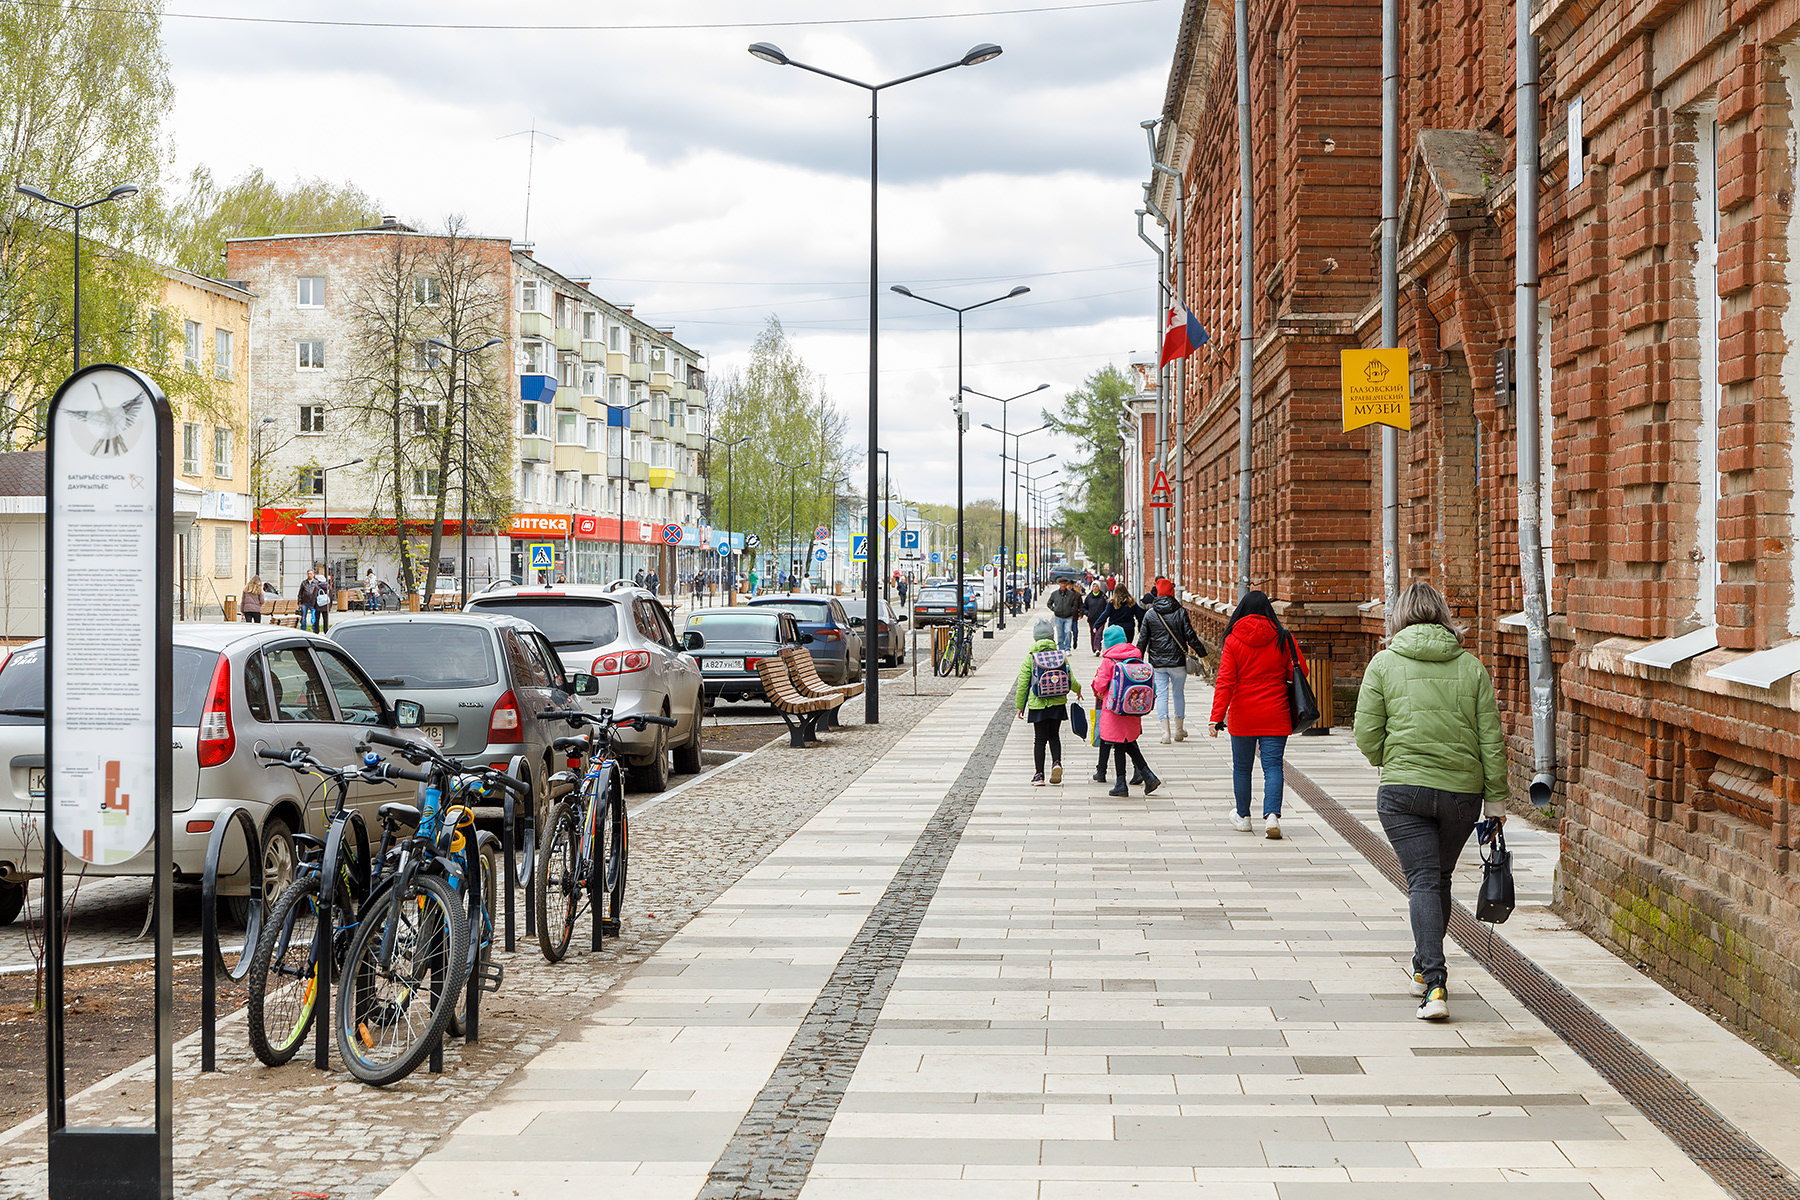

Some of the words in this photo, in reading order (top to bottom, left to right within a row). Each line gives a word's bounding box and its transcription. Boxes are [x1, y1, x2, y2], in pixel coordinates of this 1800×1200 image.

[1350, 384, 1404, 394] ГЛАЗОВСКИЙ
[1350, 393, 1404, 401] КРАЕВЕДЧЕСКИЙ
[1354, 401, 1401, 415] МУЗЕЙ
[511, 517, 568, 530] аптека
[425, 727, 438, 738] 18
